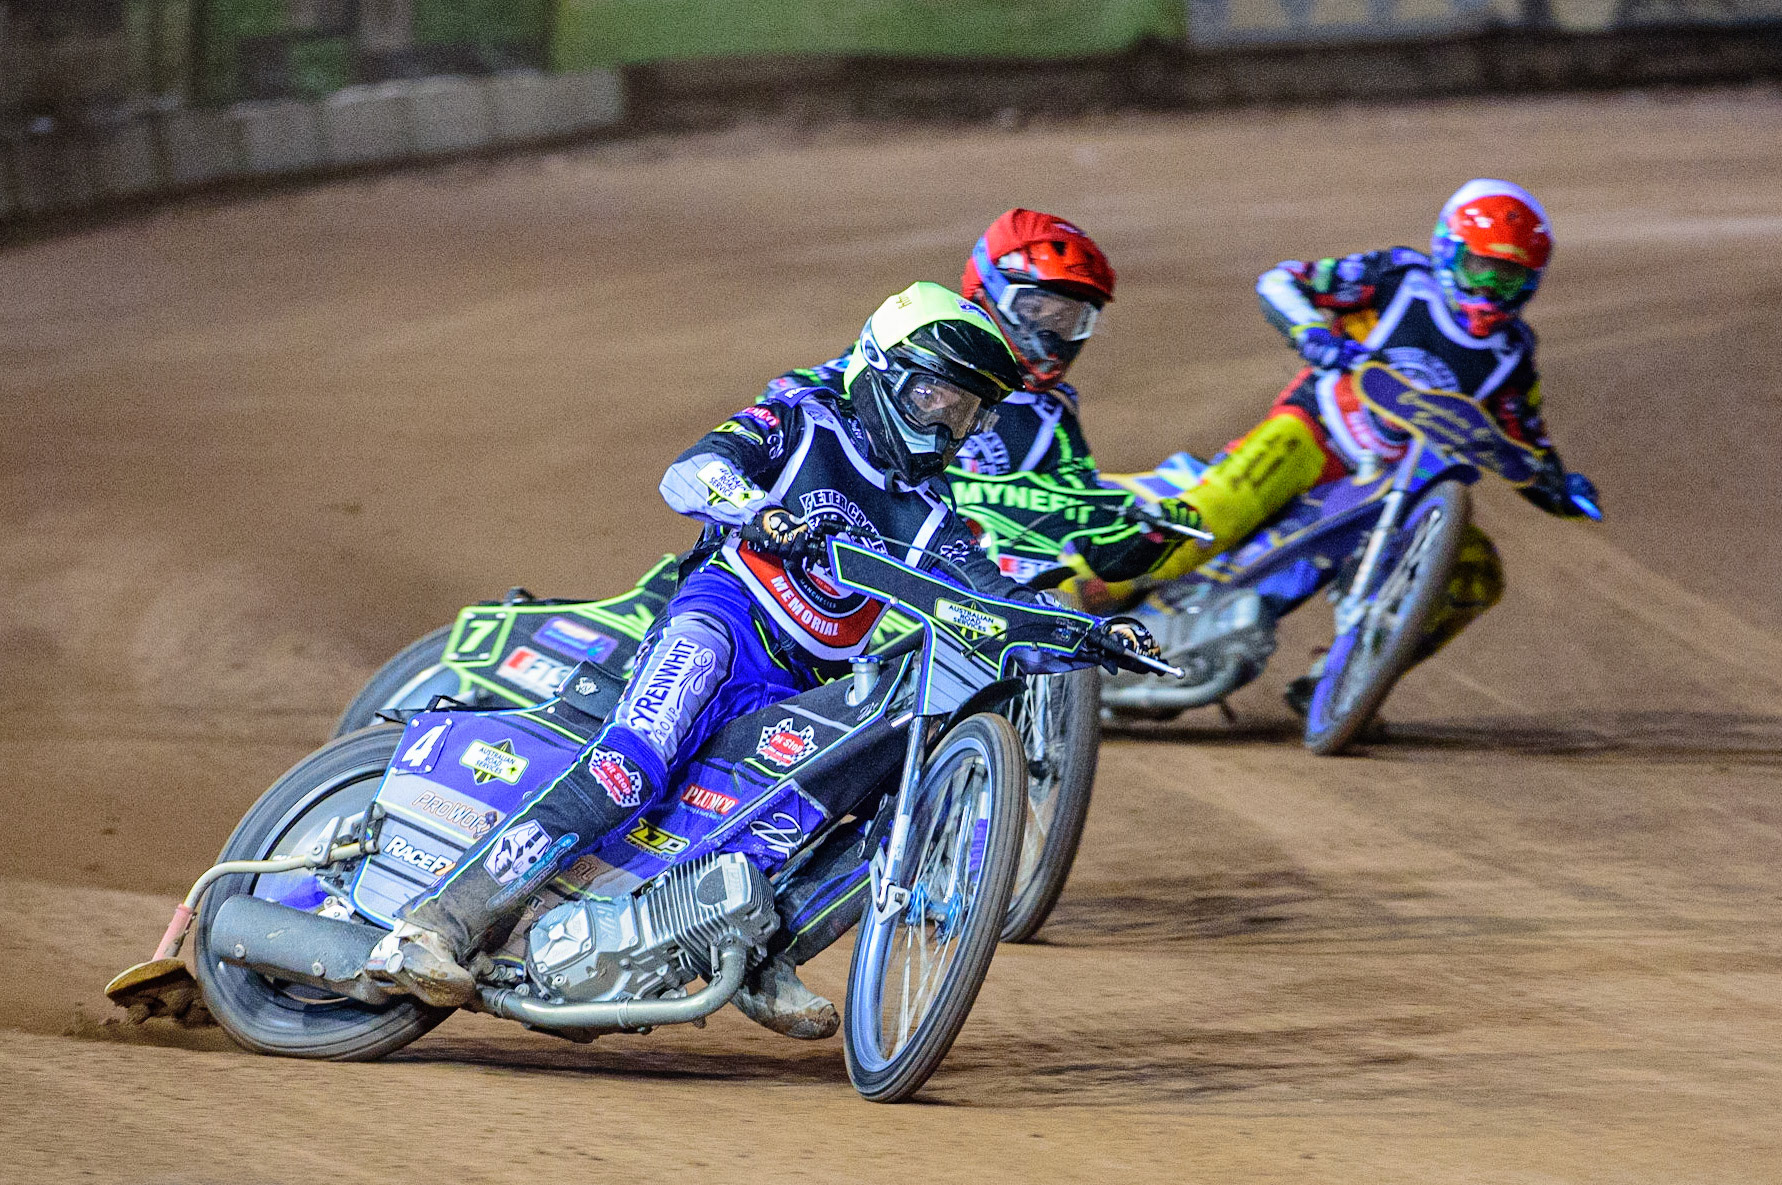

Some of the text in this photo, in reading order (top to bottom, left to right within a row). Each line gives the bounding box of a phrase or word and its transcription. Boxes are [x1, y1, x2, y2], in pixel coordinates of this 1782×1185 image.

[770, 575, 839, 637] MEMORIAL
[948, 604, 995, 624] AUSTRALIAN
[952, 616, 987, 632] SERVICES
[959, 613, 982, 626] ROAD
[458, 620, 498, 653] 7
[401, 724, 448, 767] 4
[782, 738, 804, 754] Stop
[479, 746, 516, 765] AUSTRALIAN
[484, 756, 503, 767] ROAD
[475, 759, 503, 774] SERVICES
[601, 761, 617, 774] Pit
[613, 772, 631, 795] Stop
